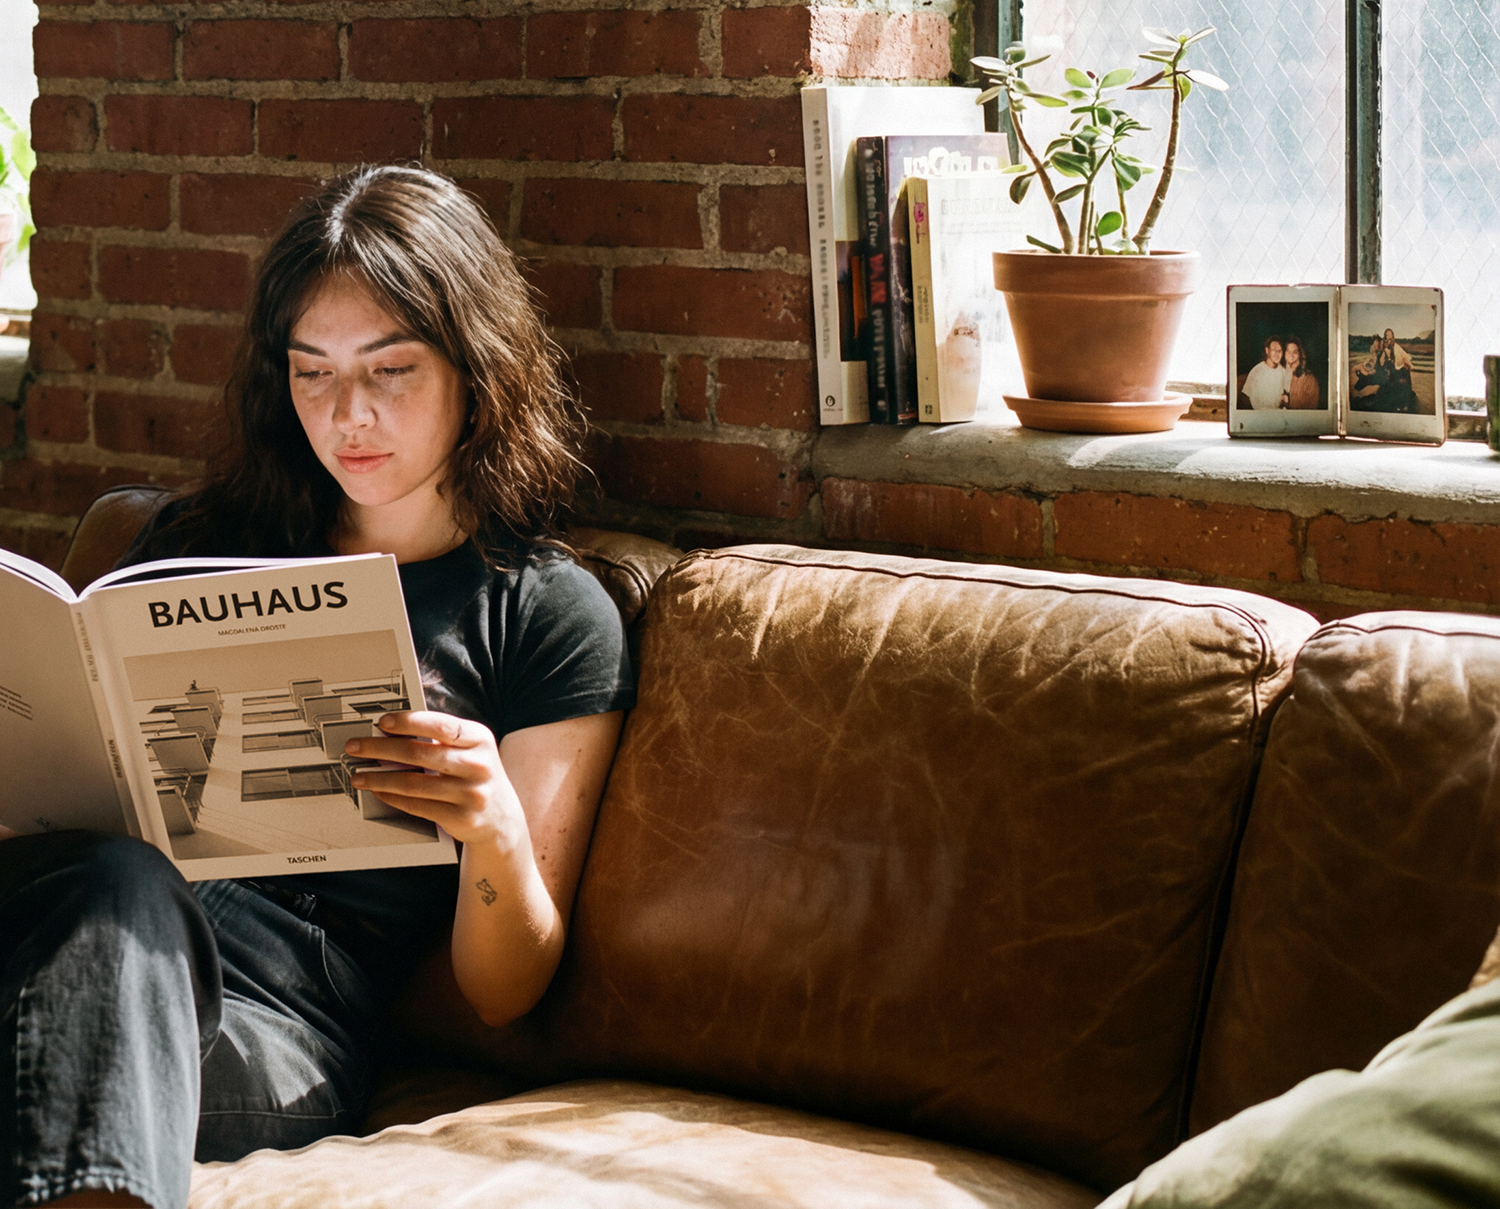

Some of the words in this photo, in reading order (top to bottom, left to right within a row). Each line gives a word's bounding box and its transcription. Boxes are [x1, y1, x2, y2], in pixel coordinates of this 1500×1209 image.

[148, 581, 348, 628] BAUHAUS
[218, 626, 259, 636] MAGDALENA
[260, 623, 286, 632] DROSTE
[287, 854, 327, 864] TASCHEN
